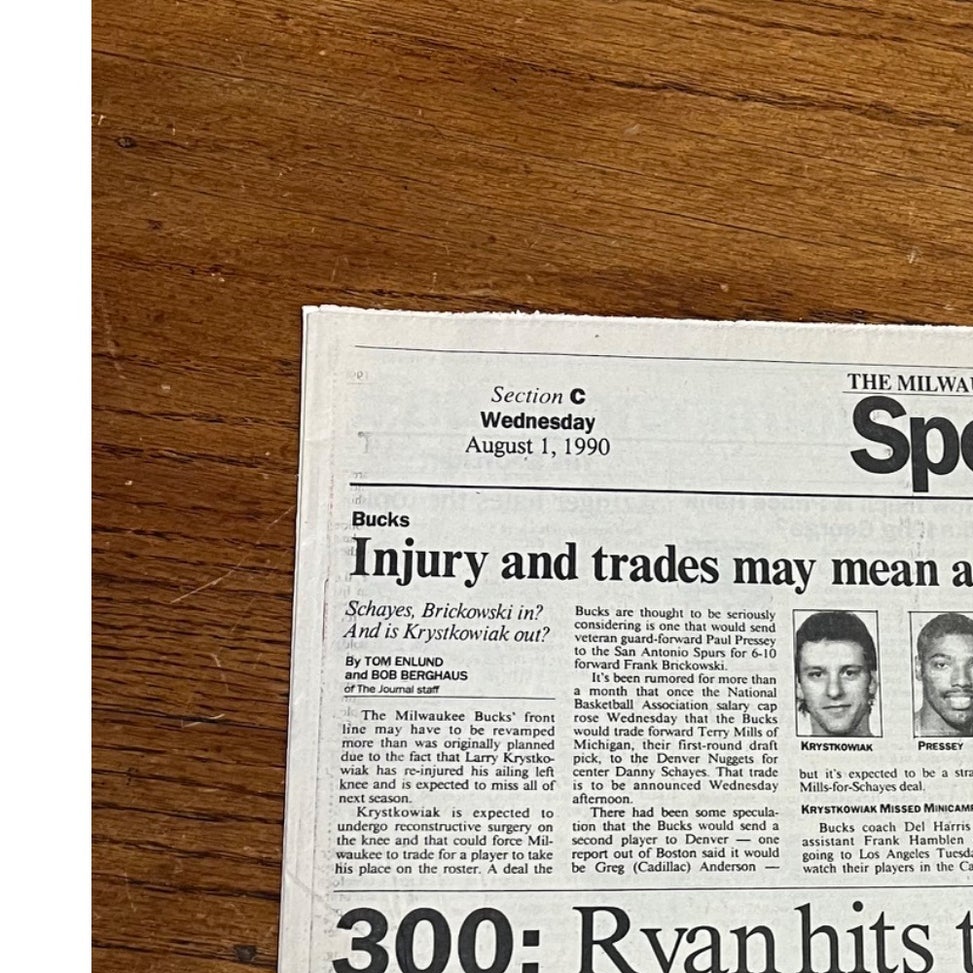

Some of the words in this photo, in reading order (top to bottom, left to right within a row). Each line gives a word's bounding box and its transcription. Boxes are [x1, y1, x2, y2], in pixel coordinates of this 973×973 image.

[847, 373, 892, 390] THE
[491, 386, 563, 404] Section
[570, 388, 586, 405] C
[480, 411, 596, 434] Wednesday
[465, 436, 533, 458] August
[541, 437, 556, 458] 1,
[565, 437, 610, 456] 1990
[352, 511, 410, 528] Bucks
[350, 536, 489, 588] Injury
[500, 542, 579, 581] and
[592, 544, 720, 584] trades
[732, 553, 816, 595] may
[830, 555, 940, 588] mean
[345, 600, 415, 620] Schayes,
[422, 603, 512, 621] Brickowski
[517, 604, 544, 621] in?
[343, 622, 382, 640] And
[385, 624, 399, 639] is
[403, 623, 511, 643] Krystkowiak
[514, 626, 551, 643] out?
[345, 656, 361, 668] By
[364, 656, 392, 667] TOM
[395, 656, 444, 668] ENLUND
[345, 670, 368, 681] and
[371, 670, 397, 680] BOB
[400, 670, 468, 681] BERGHAUS
[344, 684, 354, 694] of
[358, 684, 376, 694] The
[378, 684, 415, 694] Journal
[417, 684, 441, 694] staff
[574, 699, 633, 709] Basketball
[642, 700, 708, 710] Association
[716, 701, 749, 712] salary
[757, 703, 777, 713] cap
[573, 726, 609, 736] would
[614, 726, 644, 736] trade
[648, 726, 693, 736] forward
[697, 726, 729, 738] Terry
[734, 727, 762, 737] Mills
[766, 727, 779, 737] of
[342, 740, 374, 748] more
[381, 737, 407, 748] than
[415, 740, 437, 748] was
[444, 738, 500, 751] originally
[507, 739, 554, 751] planned
[574, 739, 634, 752] Michigan,
[642, 740, 671, 750] their
[678, 739, 742, 750] first-round
[749, 740, 778, 750] draft
[800, 740, 873, 752] KRYSTKOWIAK
[917, 740, 964, 752] PRESSEY
[800, 781, 896, 793] Mills-for-Schayes
[899, 781, 925, 791] deal.
[572, 793, 633, 804] afternoon.
[801, 804, 877, 815] KRYSTKOWIAK
[880, 803, 921, 814] MISSED
[338, 820, 388, 834] undergo
[395, 821, 481, 832] reconstructive
[488, 824, 531, 834] surgery
[537, 824, 553, 832] on
[819, 822, 855, 833] Bucks
[862, 822, 896, 832] coach
[904, 822, 924, 832] Del
[934, 821, 970, 831] Harris
